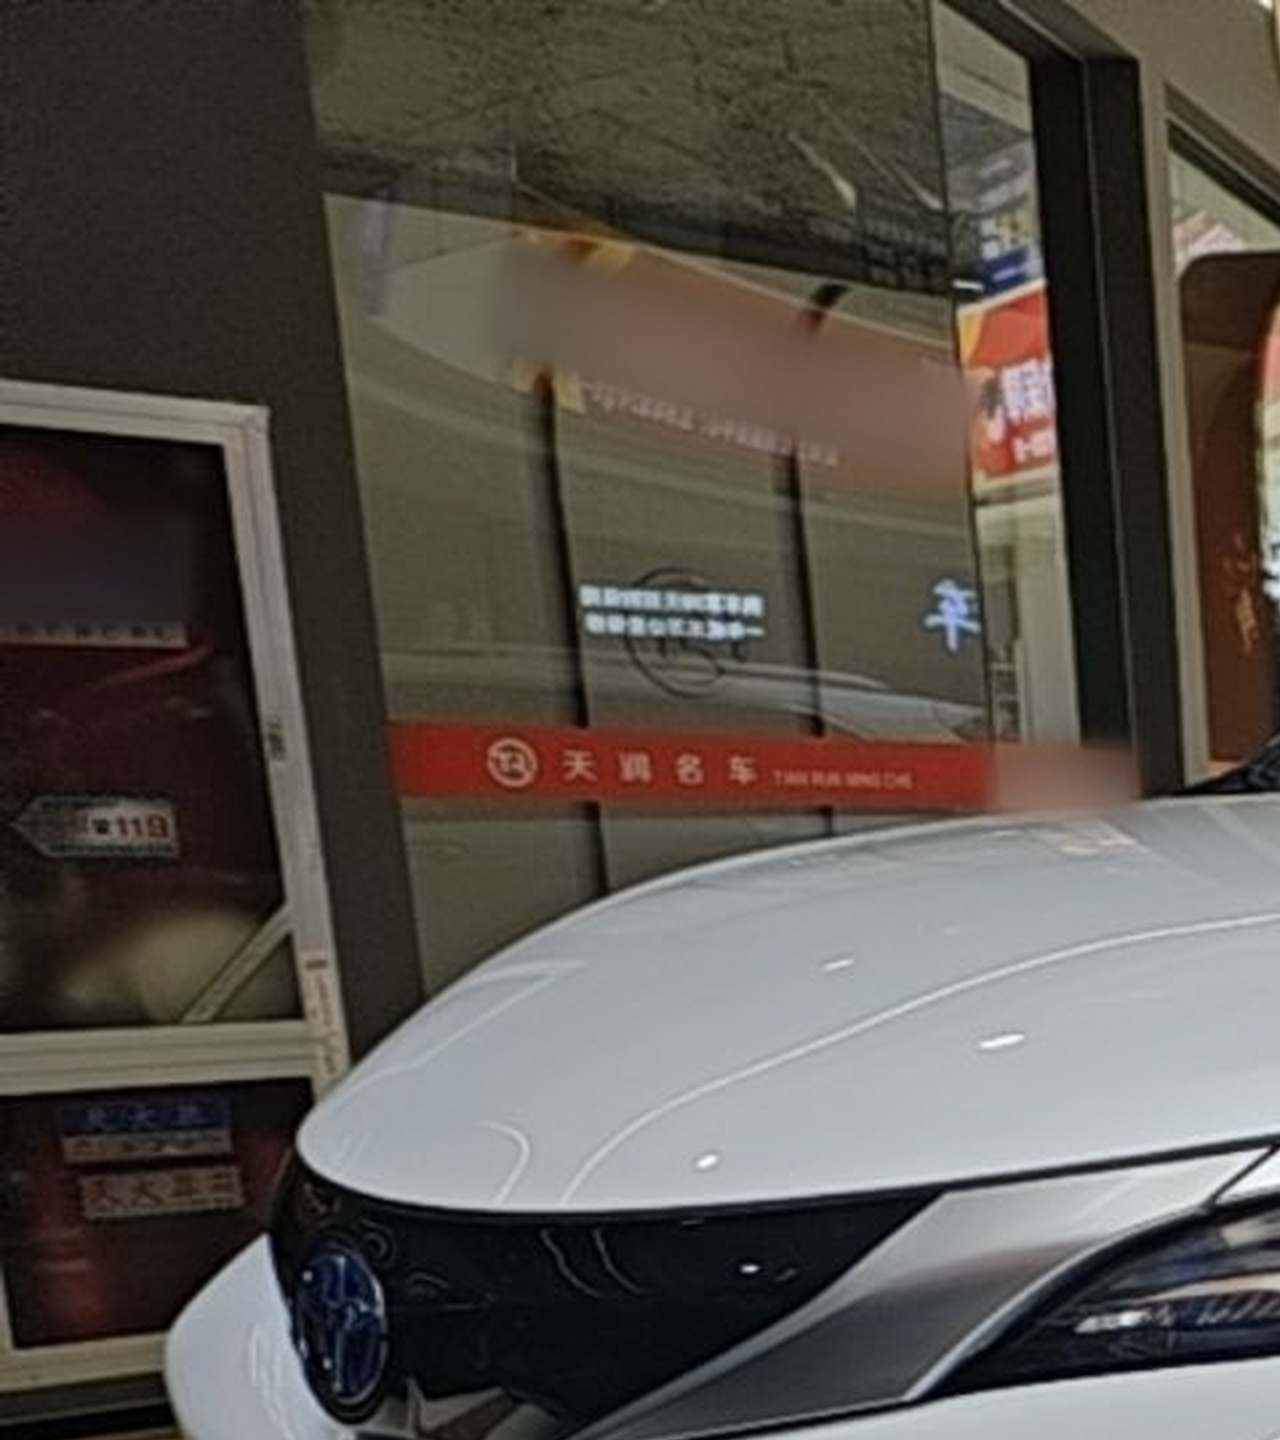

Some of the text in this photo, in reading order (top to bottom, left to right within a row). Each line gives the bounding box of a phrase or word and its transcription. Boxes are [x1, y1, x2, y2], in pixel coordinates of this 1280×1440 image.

[562, 749, 758, 785] 天润名车
[117, 814, 170, 838] 119
